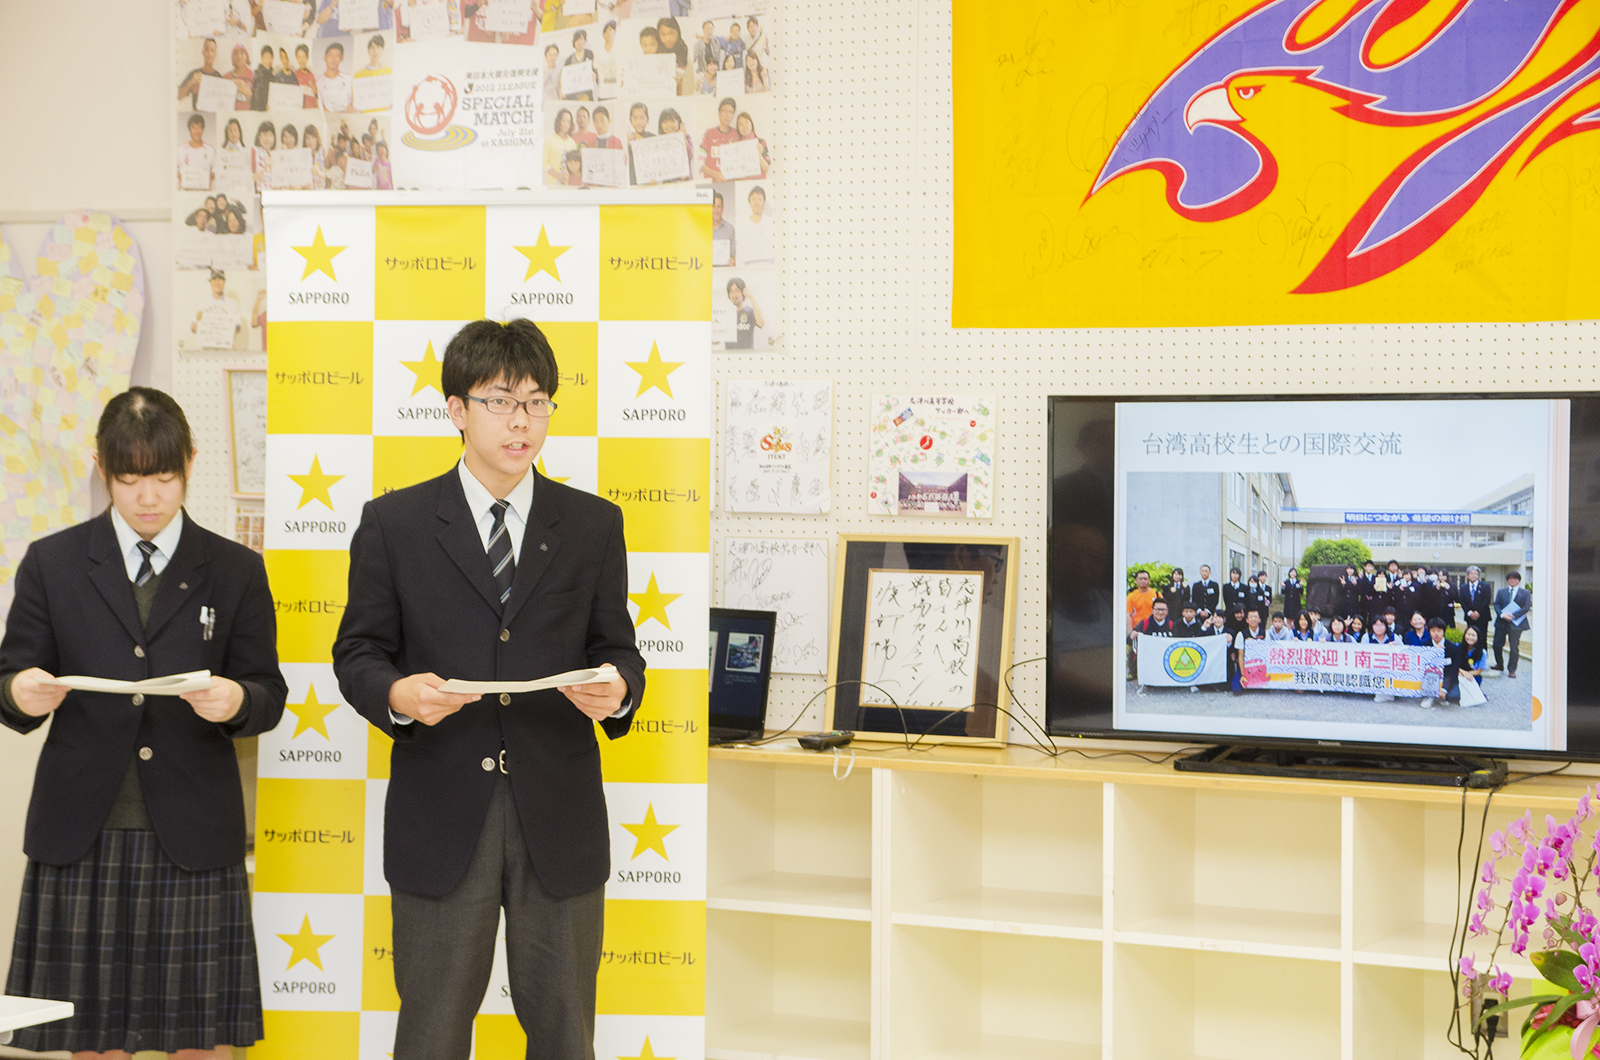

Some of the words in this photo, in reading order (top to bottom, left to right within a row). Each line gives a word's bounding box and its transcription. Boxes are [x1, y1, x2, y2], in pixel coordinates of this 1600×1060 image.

[462, 94, 534, 111] SPECIAL
[473, 110, 534, 126] MATCH
[498, 128, 516, 138] July
[518, 127, 534, 137] 21st
[491, 137, 534, 148] KASHIMA
[384, 256, 477, 271] サッポロビール
[609, 256, 703, 271] サッポロビール
[288, 292, 350, 305] SAPPORO
[510, 292, 574, 305] SAPPORO
[275, 370, 364, 385] サッポロビール
[397, 407, 450, 420] SAPPOR
[622, 408, 686, 421] SAPPORO
[1142, 431, 1403, 458] 台湾高校生との国際交流
[606, 487, 701, 503] サッポロビール
[284, 520, 346, 533] SAPPORO
[274, 600, 346, 613] サッポロビー
[639, 640, 683, 652] PPORO
[632, 719, 698, 733] ポロビール
[279, 749, 342, 762] SAPPORO
[264, 828, 356, 844] サッポロビール
[617, 870, 681, 883] SAPPORO
[601, 950, 696, 965] サッポロビール
[272, 981, 336, 994] SAPPORO
